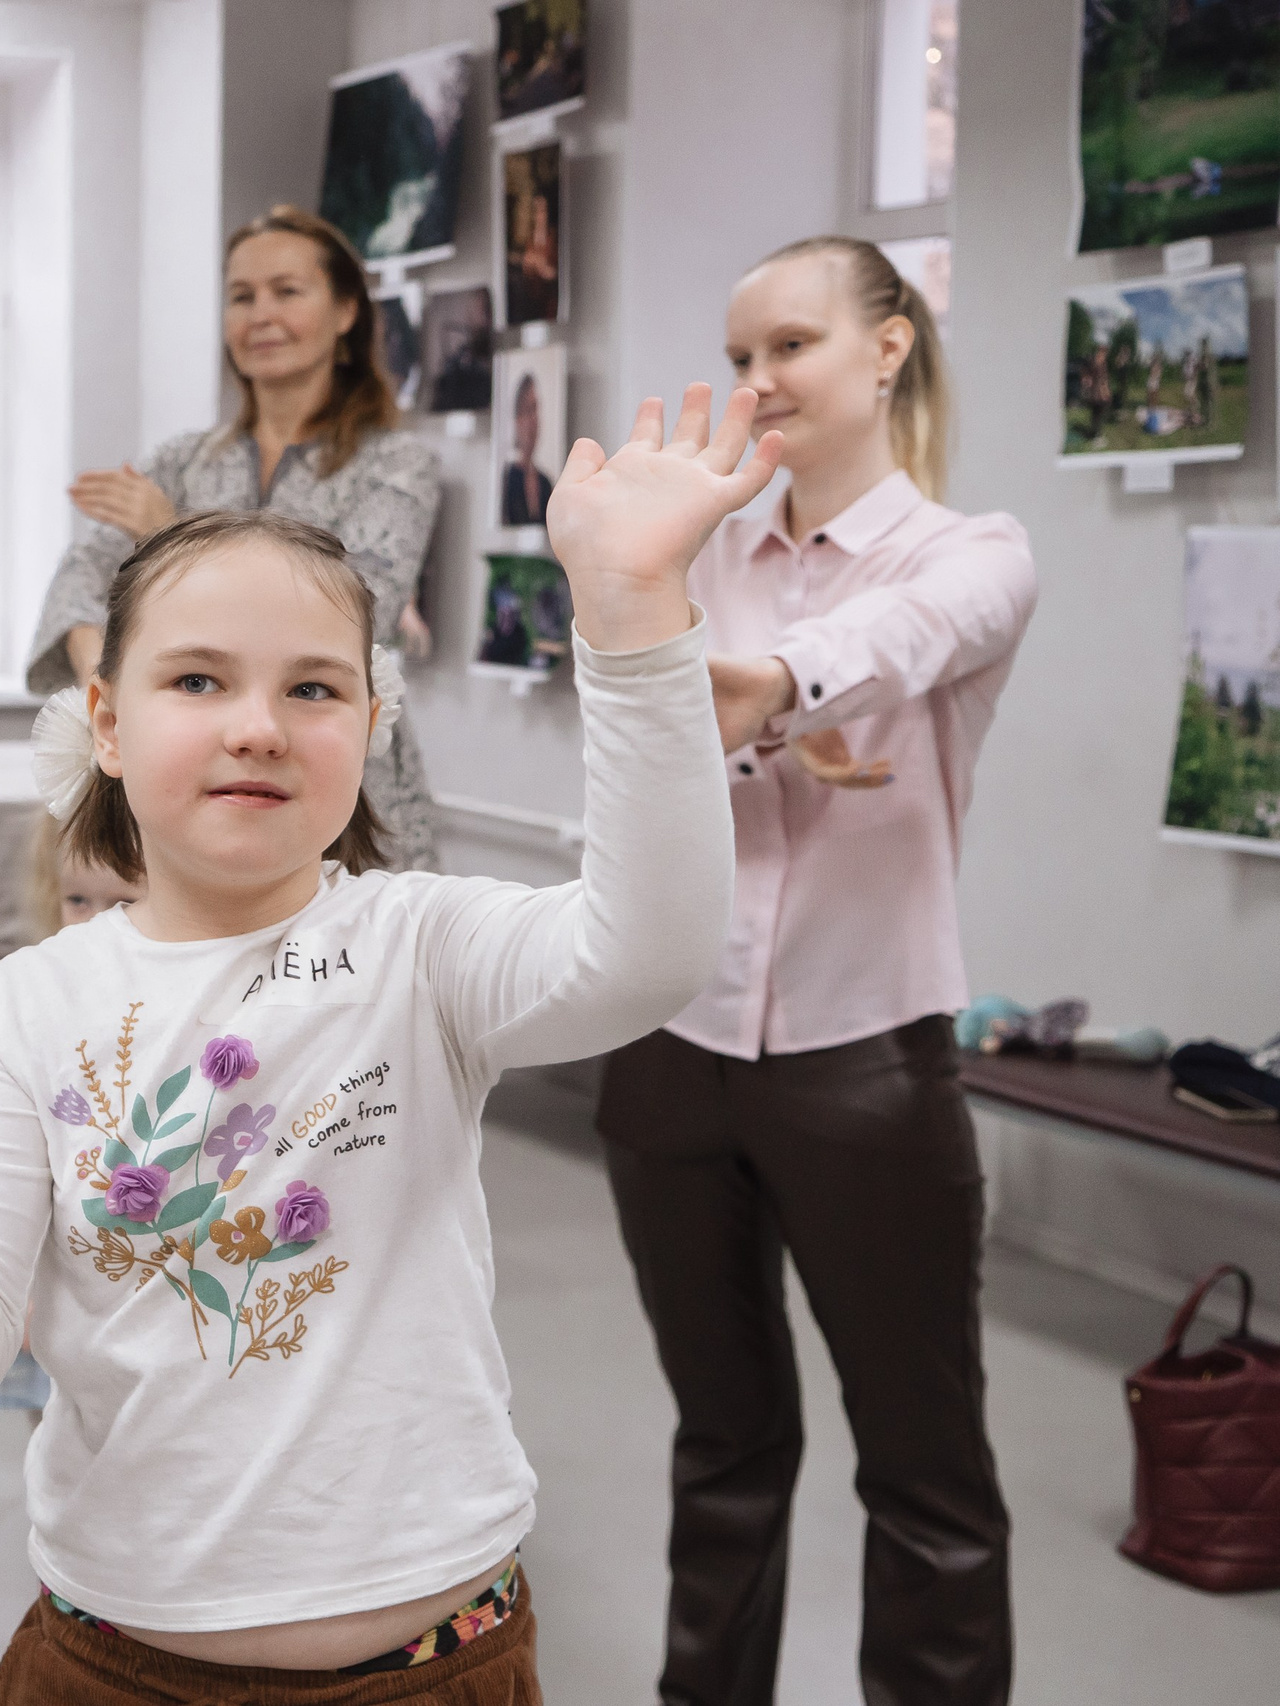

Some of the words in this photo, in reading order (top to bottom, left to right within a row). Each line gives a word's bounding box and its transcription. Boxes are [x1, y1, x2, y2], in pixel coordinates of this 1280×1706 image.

[274, 1136, 293, 1157] all
[291, 1093, 337, 1139] GOOD
[339, 1061, 391, 1094] things
[307, 1118, 351, 1149] come
[357, 1101, 397, 1121] from
[333, 1133, 386, 1157] nature
